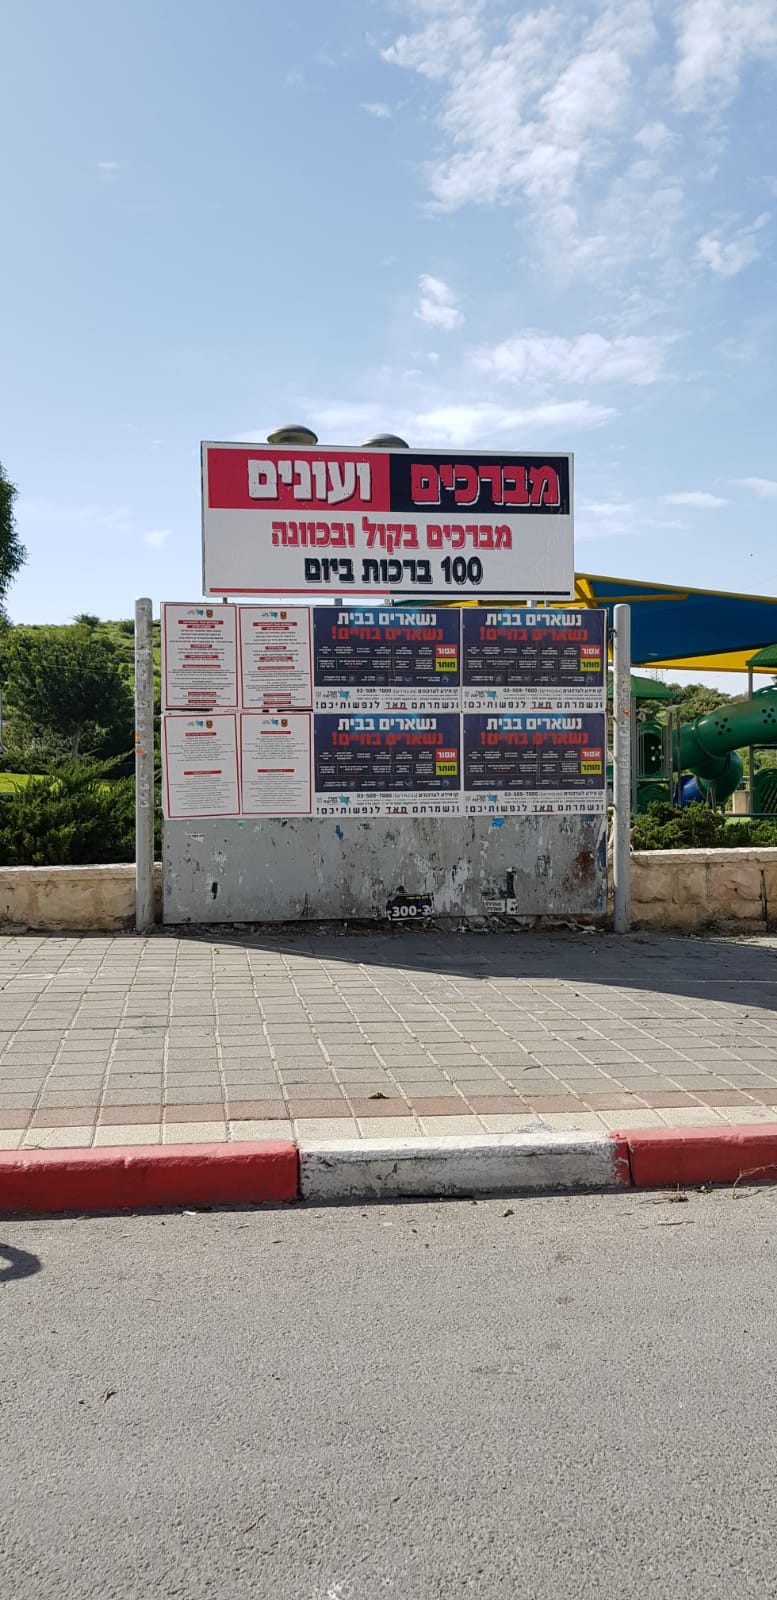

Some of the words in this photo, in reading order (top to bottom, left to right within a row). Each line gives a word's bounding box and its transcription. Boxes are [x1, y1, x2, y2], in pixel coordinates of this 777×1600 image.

[247, 459, 371, 504] ועונים
[411, 464, 560, 506] מברכים
[271, 520, 355, 548] ובכוונה
[362, 516, 419, 555] בקול
[426, 524, 513, 550] מברכים
[304, 557, 354, 583] ביום
[362, 557, 433, 584] ברכות
[441, 556, 483, 585] 100
[337, 612, 374, 625] בבית
[379, 613, 437, 626] נשארים
[485, 613, 521, 626] בבית
[526, 614, 582, 626] נשארים
[331, 626, 381, 640] בחיים!
[385, 627, 443, 640] נשארים
[480, 627, 528, 641] בחיים!
[531, 628, 588, 641] נשארים
[437, 647, 456, 655] אסור
[437, 660, 456, 668] מותר
[337, 718, 374, 730] בבית
[379, 718, 437, 730] נשארים
[486, 718, 523, 730] בבית
[526, 718, 582, 730] נשארים
[331, 731, 381, 745] בחיים!
[385, 732, 443, 745] נשארים
[480, 732, 528, 745] בחיים!
[532, 732, 589, 745] נשארים
[437, 764, 456, 772] מותר
